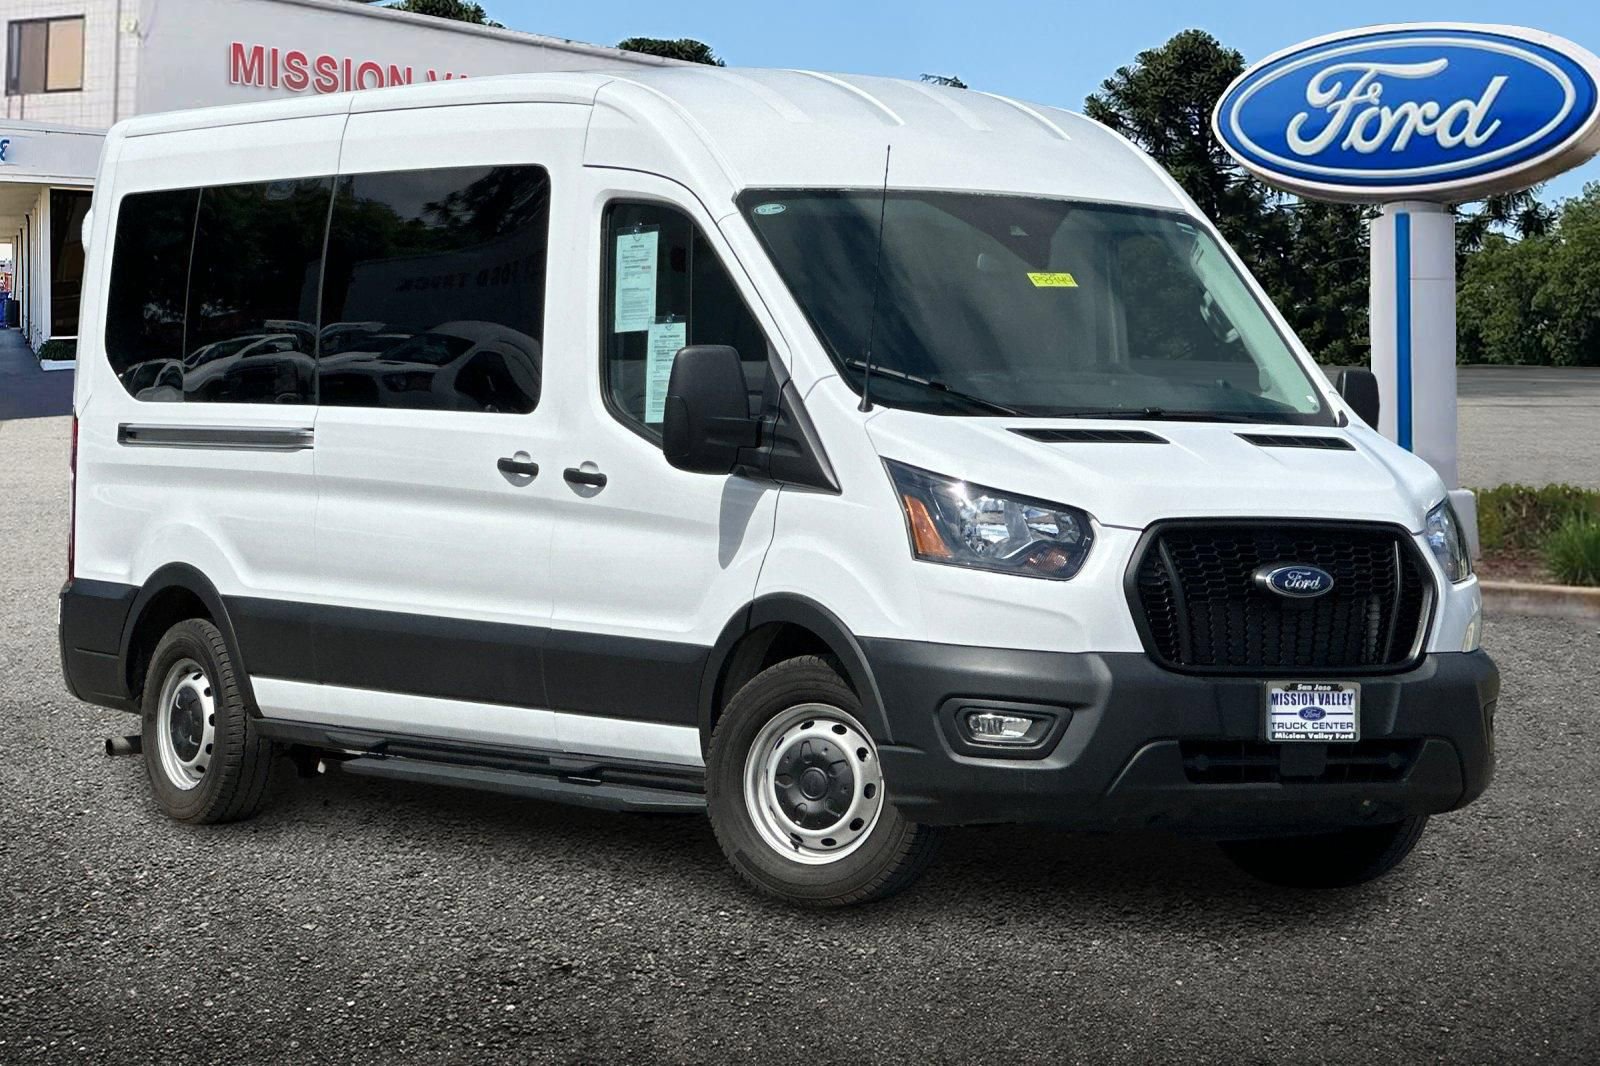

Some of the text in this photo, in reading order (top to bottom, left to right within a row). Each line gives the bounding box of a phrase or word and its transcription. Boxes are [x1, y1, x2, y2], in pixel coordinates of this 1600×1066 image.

[229, 41, 413, 93] MISSION
[1286, 57, 1509, 156] Ford
[1284, 571, 1321, 589] Ford
[1271, 692, 1354, 706] MISSION VALLEY
[1303, 708, 1322, 718] Ford
[1271, 722, 1354, 730] TRUCK CENTER
[1307, 732, 1334, 740] Valley
